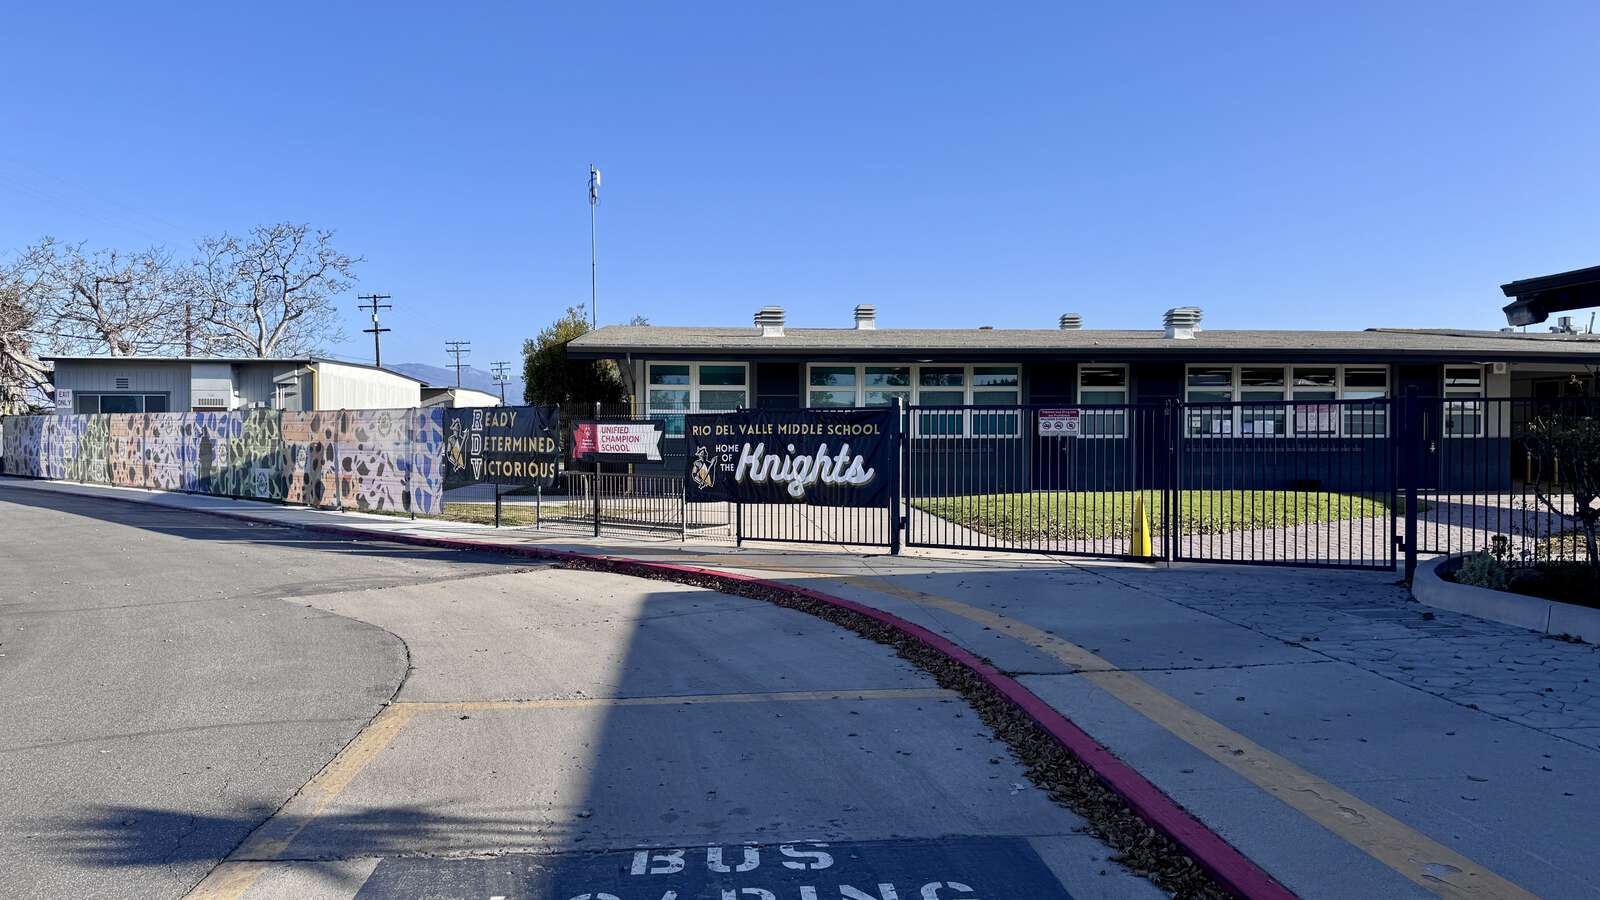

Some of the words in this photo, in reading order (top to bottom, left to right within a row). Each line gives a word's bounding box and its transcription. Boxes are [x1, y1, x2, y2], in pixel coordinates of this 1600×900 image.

[472, 409, 516, 430] READY
[692, 425, 711, 436] RIO
[716, 425, 735, 436] DEL
[739, 424, 773, 434] VALLE
[778, 424, 822, 434] MIDDLE
[828, 424, 880, 435] SCHOOL
[470, 433, 555, 455] DETERMINED
[716, 444, 739, 452] HOME
[720, 463, 734, 472] THE
[722, 454, 732, 462] OF
[470, 458, 555, 480] VICTORIOUS
[734, 442, 876, 498] Knights
[630, 840, 834, 875] BUS
